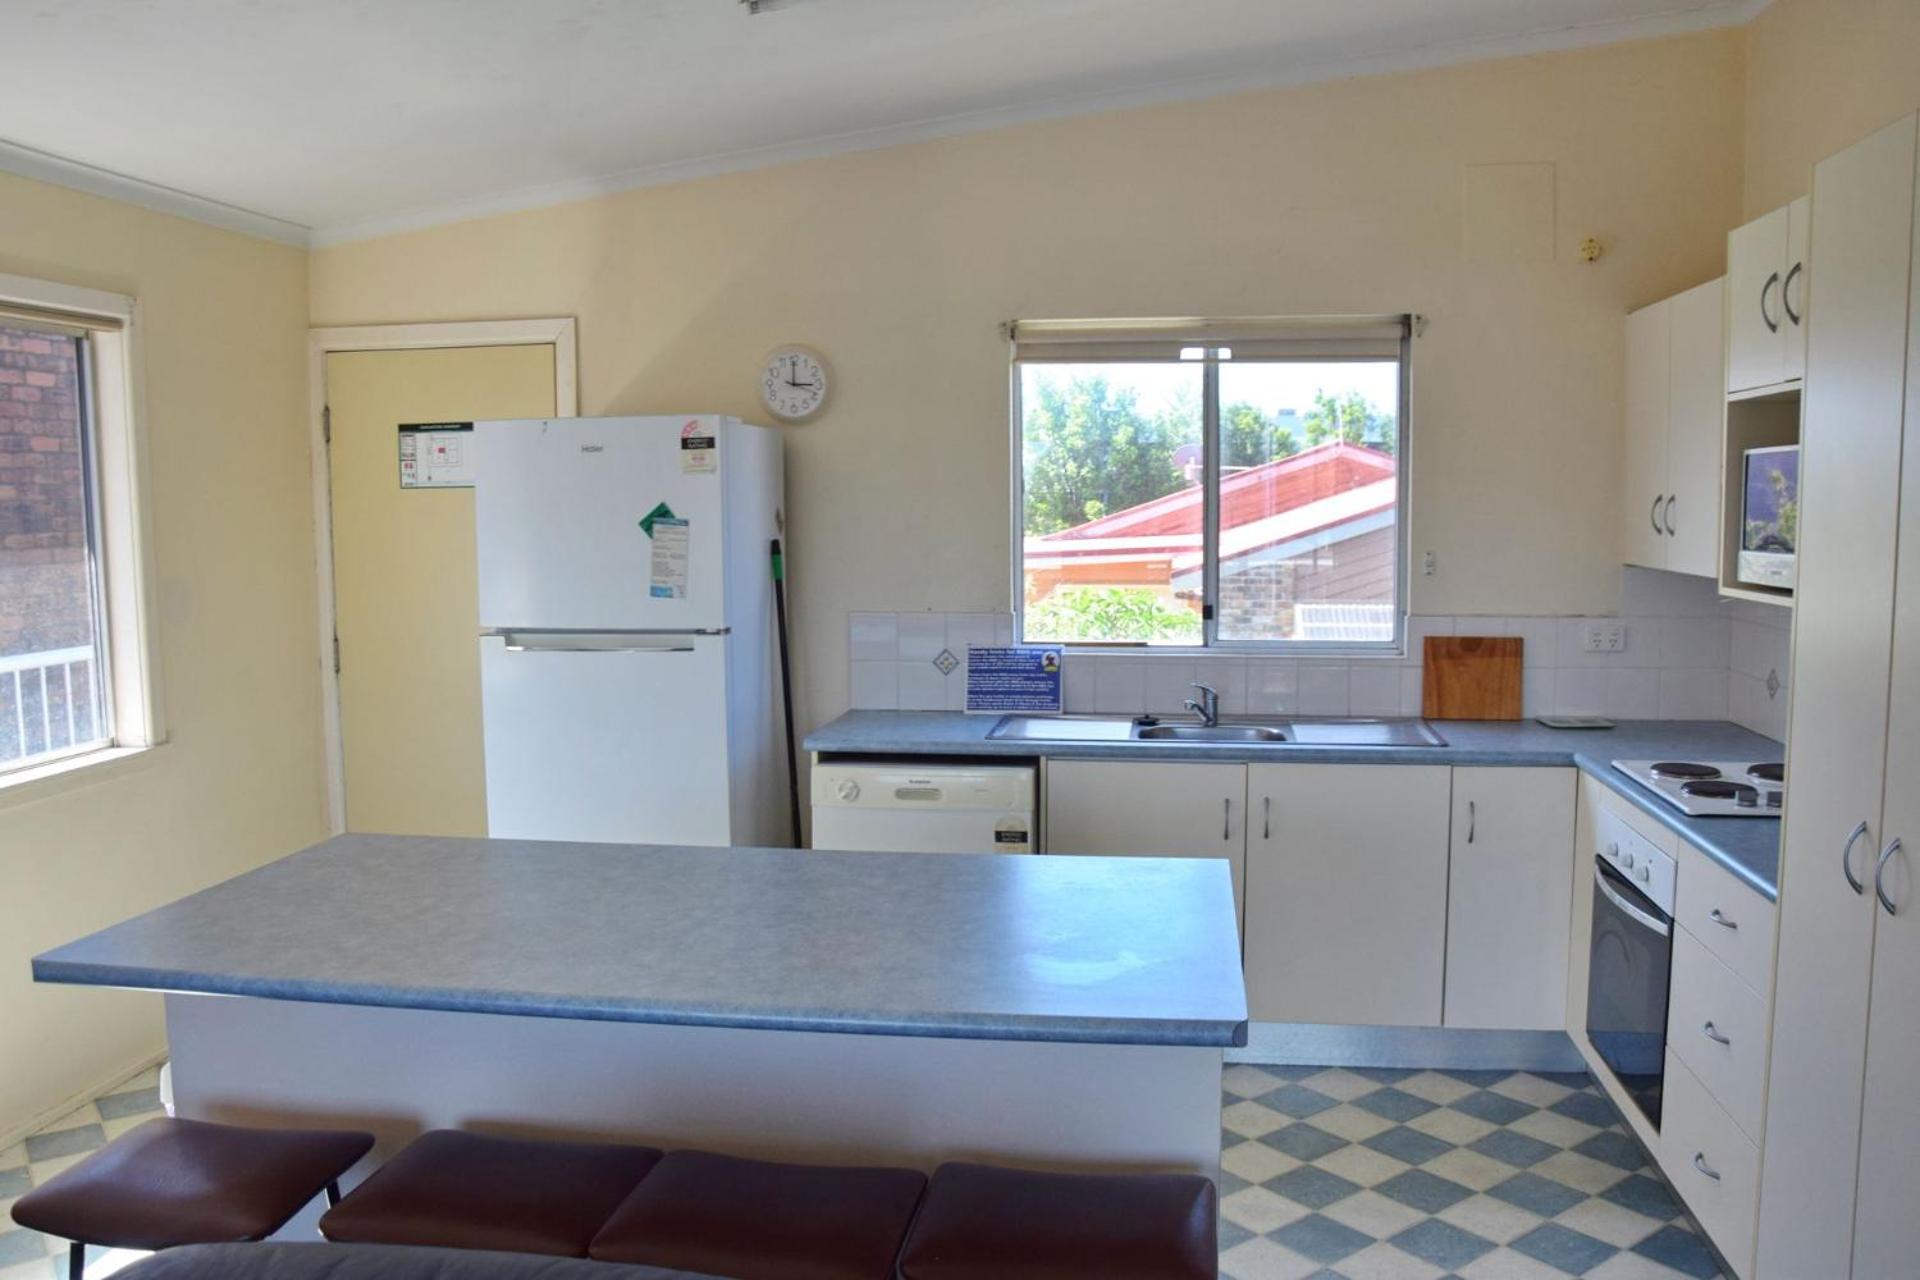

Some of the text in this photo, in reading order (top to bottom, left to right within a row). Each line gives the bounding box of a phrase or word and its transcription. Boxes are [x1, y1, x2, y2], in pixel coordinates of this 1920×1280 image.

[788, 355, 799, 367] 12
[769, 367, 779, 379] 10
[810, 364, 818, 377] 2
[766, 378, 774, 389] 9
[815, 378, 823, 391] 3
[769, 389, 777, 401] 8
[789, 403, 798, 414] 6
[581, 444, 603, 453] Haier
